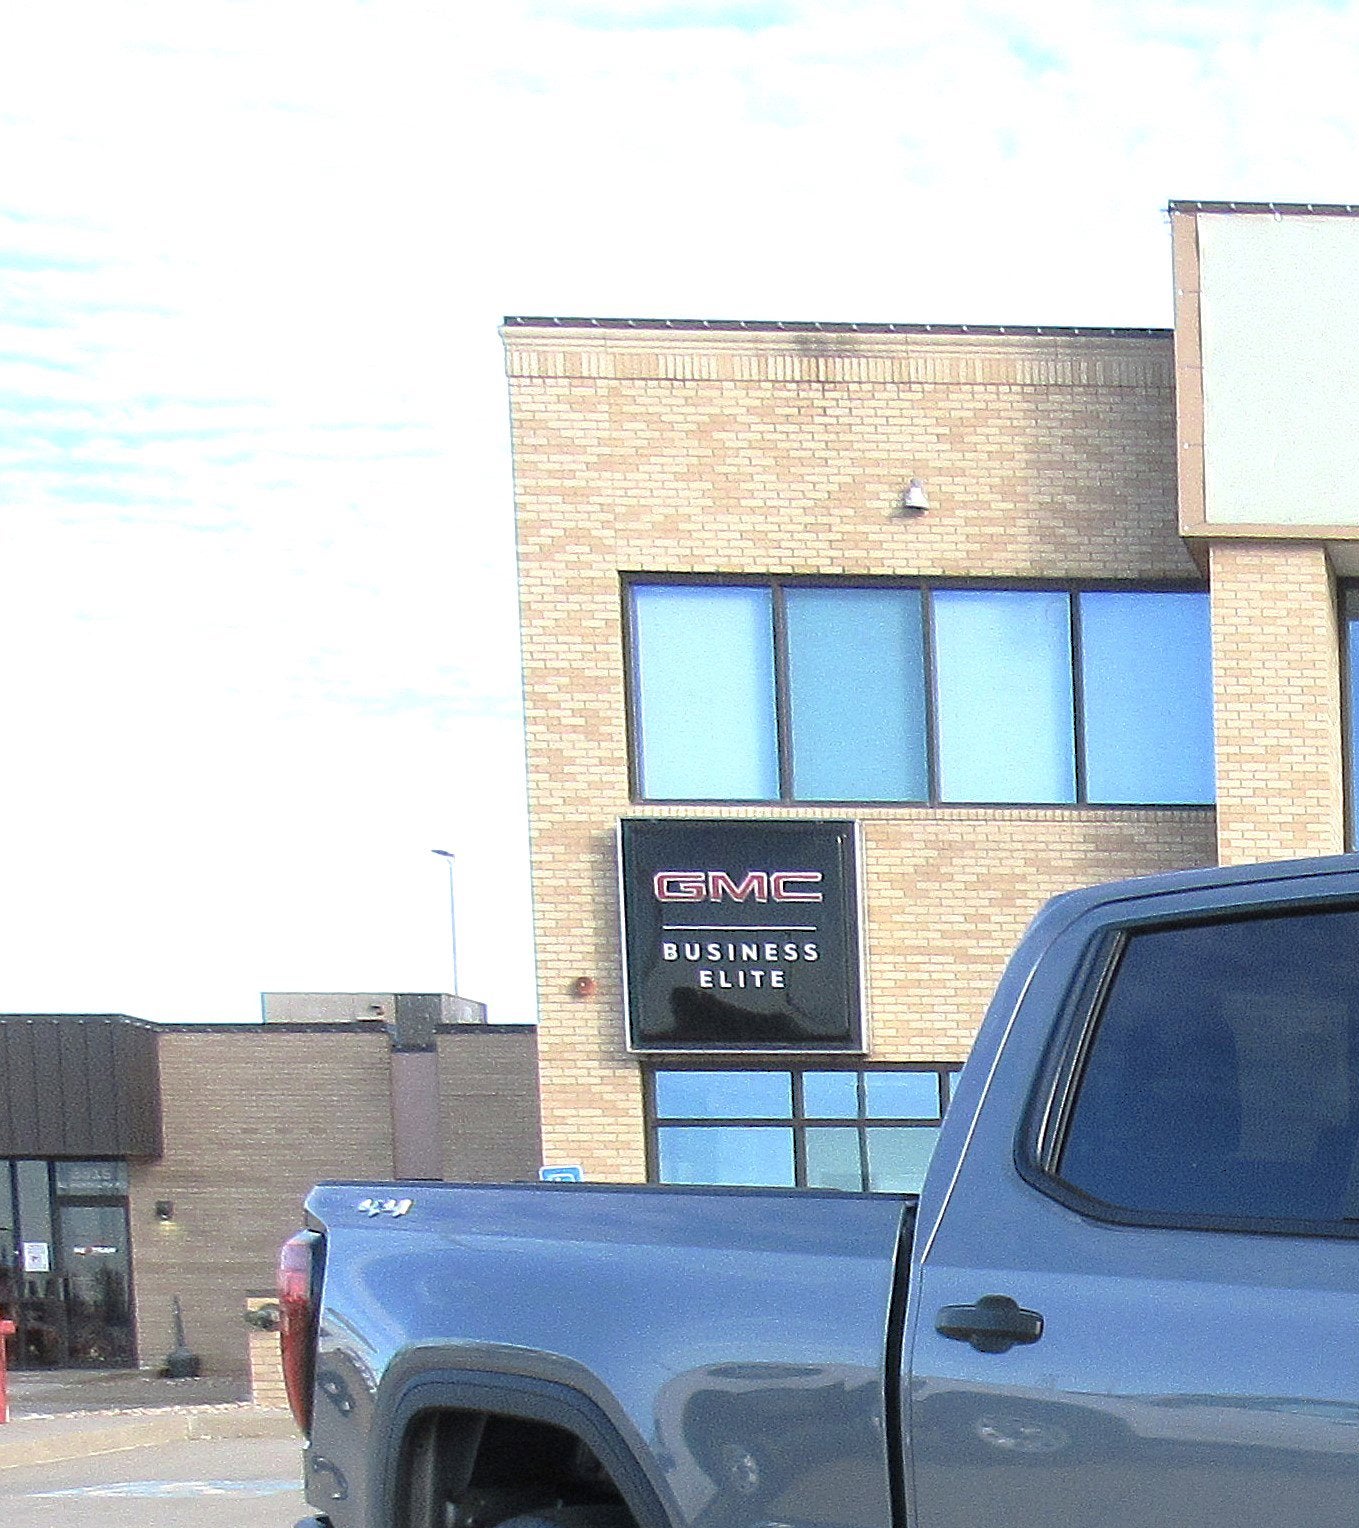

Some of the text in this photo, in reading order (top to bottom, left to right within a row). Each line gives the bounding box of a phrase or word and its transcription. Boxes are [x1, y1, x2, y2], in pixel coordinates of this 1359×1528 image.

[653, 870, 823, 903] GMC
[662, 942, 820, 962] BUSINESS
[699, 969, 786, 989] ELITE
